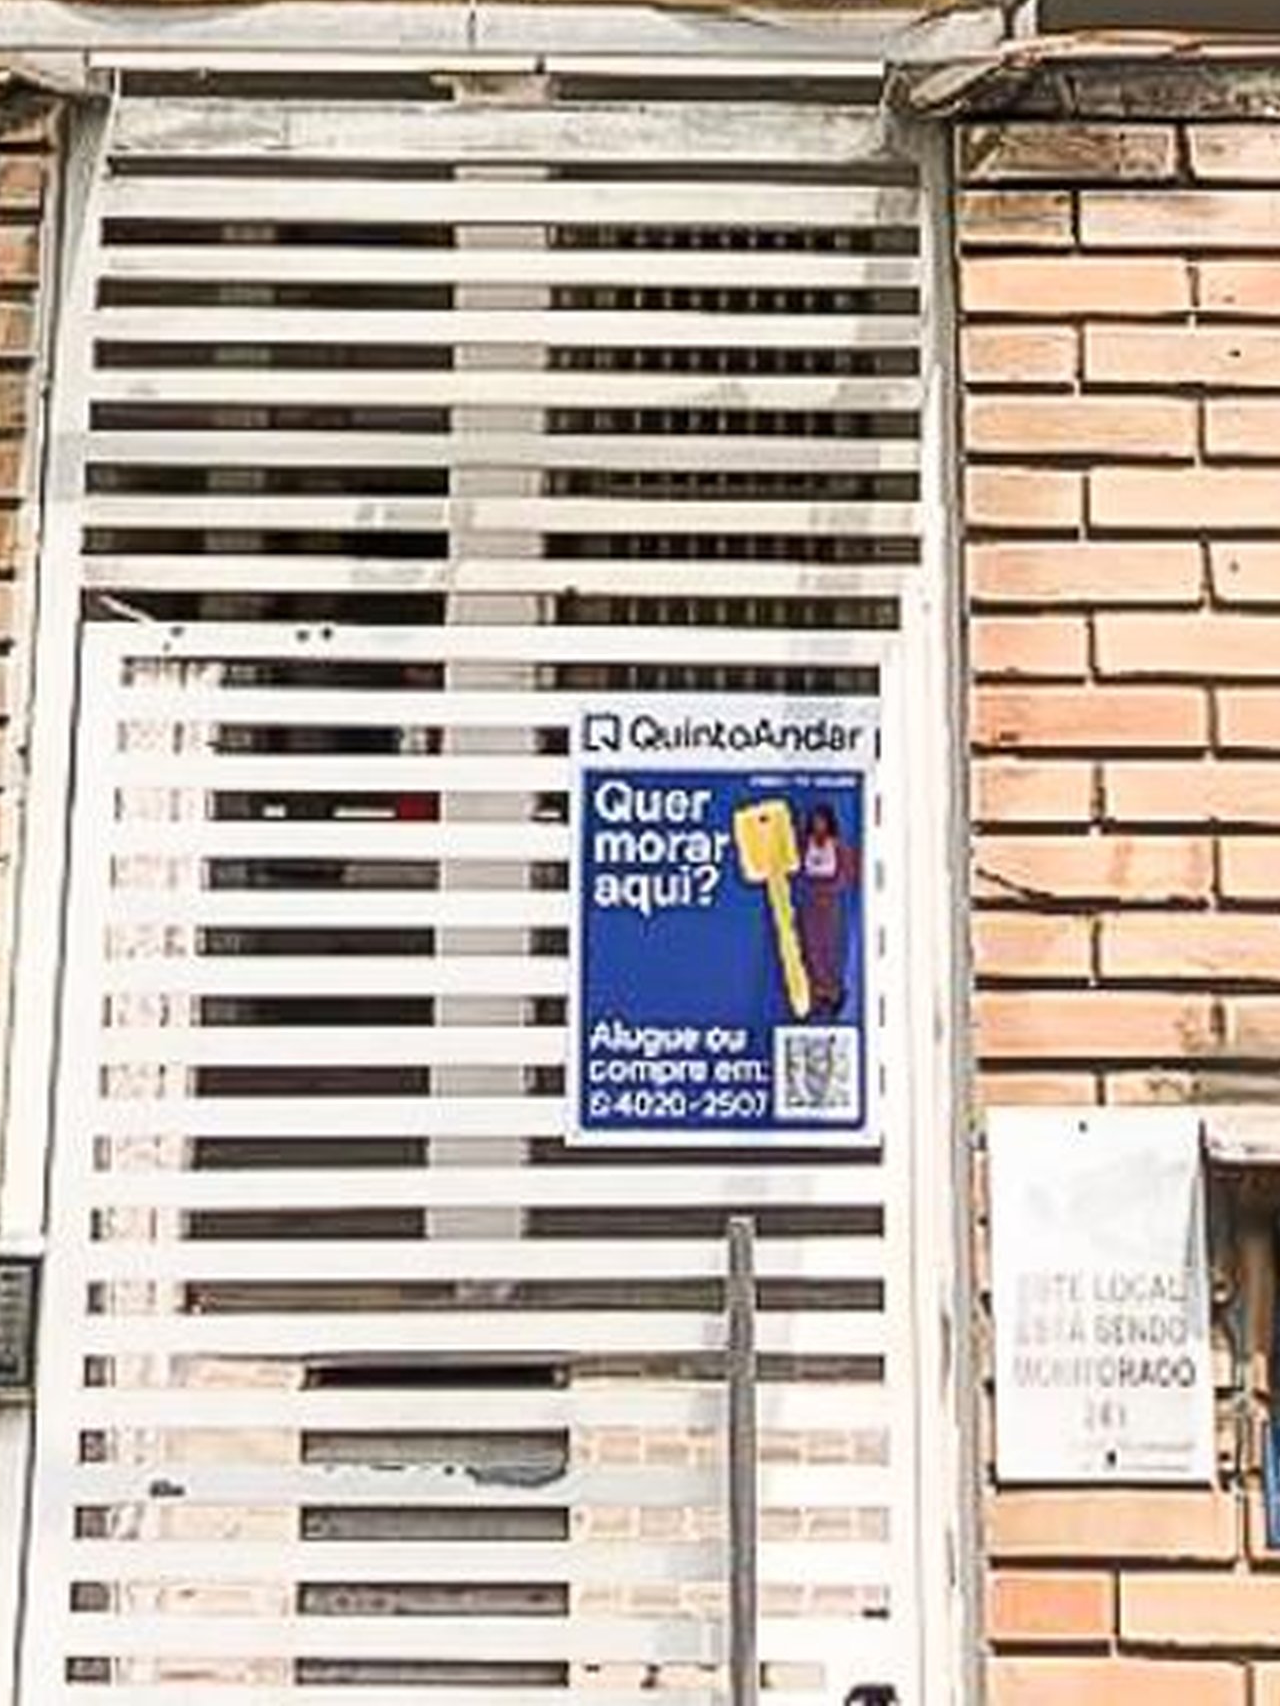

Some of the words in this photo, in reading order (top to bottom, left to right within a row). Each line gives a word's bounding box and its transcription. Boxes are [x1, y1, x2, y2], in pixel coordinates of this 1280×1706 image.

[629, 714, 862, 752] QuintoAndar
[595, 781, 711, 822] Quer
[595, 830, 730, 864] morar
[594, 866, 720, 916] aqui?
[590, 1021, 700, 1057] Alugue
[705, 1027, 748, 1053] ou
[589, 1060, 708, 1086] compre
